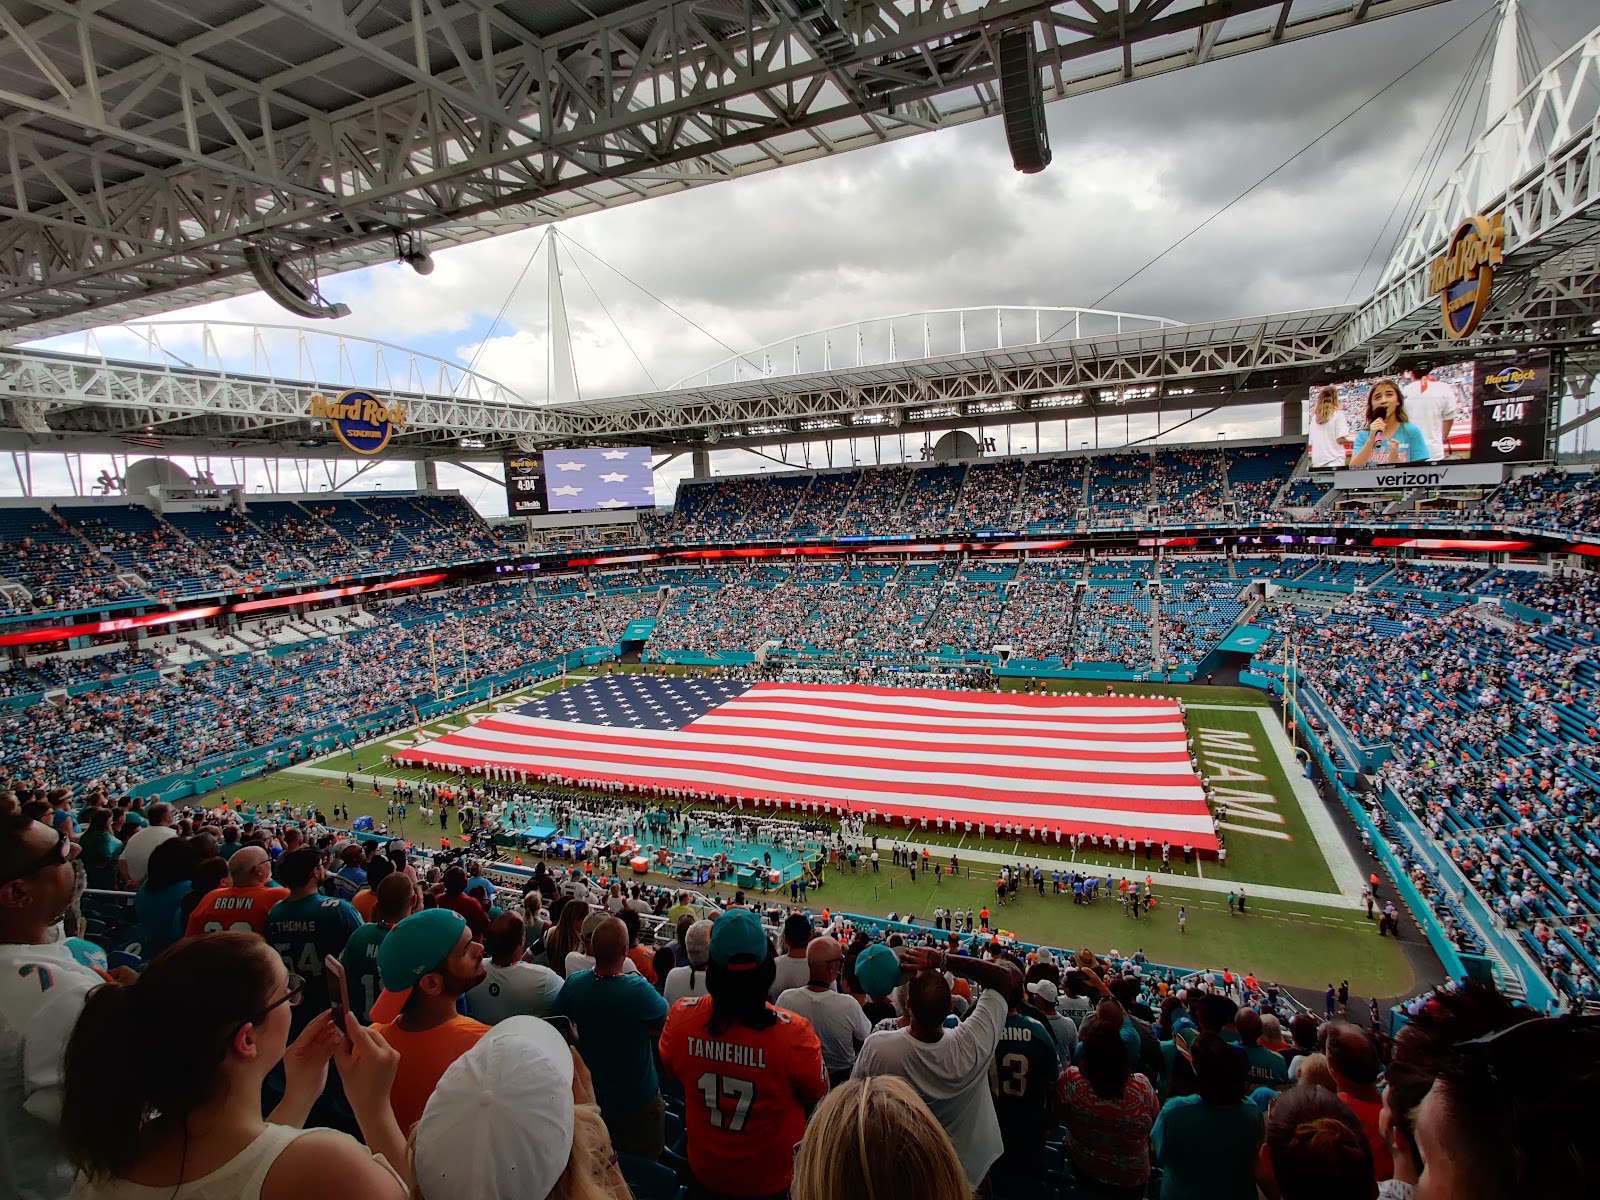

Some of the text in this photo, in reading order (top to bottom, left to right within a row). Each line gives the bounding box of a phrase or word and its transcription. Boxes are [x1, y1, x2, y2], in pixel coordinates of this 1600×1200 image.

[1429, 240, 1461, 296] Hard
[1484, 369, 1536, 385] Hard Rock
[310, 396, 407, 428] Hard Rock
[1492, 403, 1524, 422] 4:04
[346, 429, 382, 438] STADIUM
[517, 480, 536, 491] 4:04
[1376, 472, 1440, 486] verizon
[1197, 727, 1293, 841] MIAMI
[214, 897, 254, 910] BROWN
[277, 920, 316, 933] THOMAS
[687, 1036, 766, 1069] TANNEHILL
[697, 1072, 754, 1131] 17
